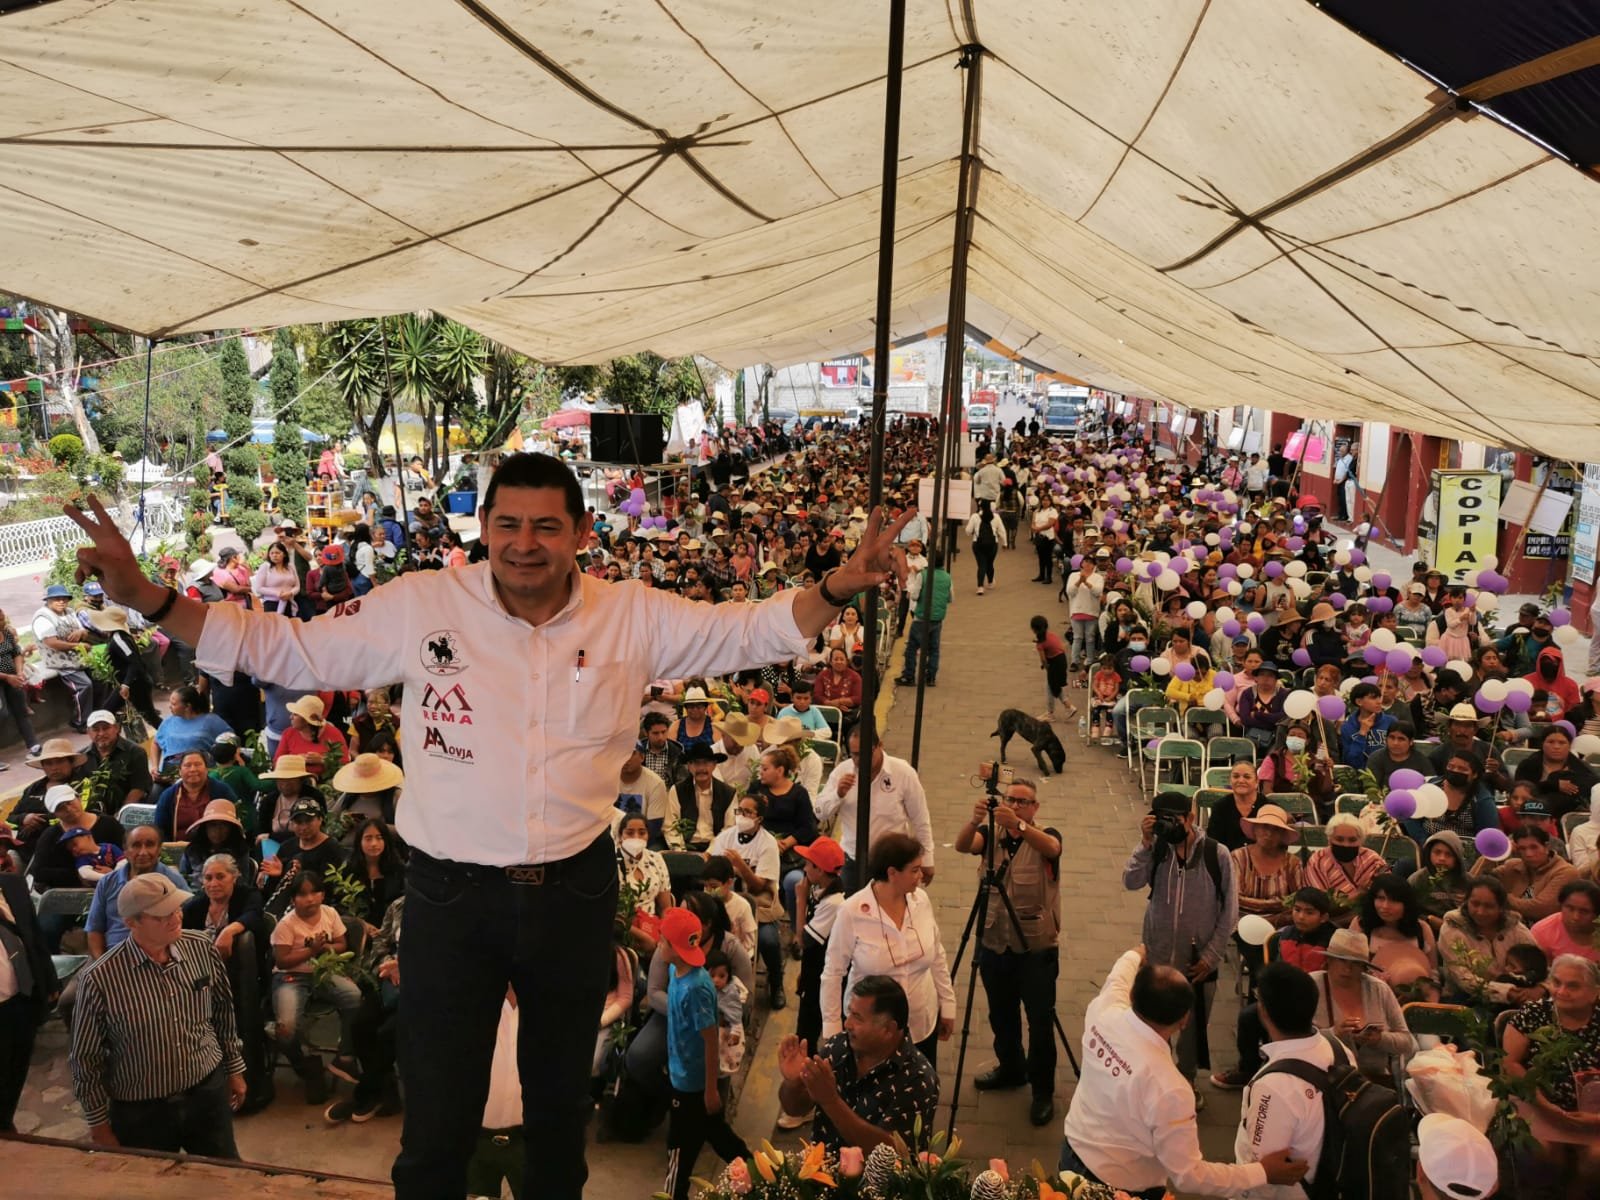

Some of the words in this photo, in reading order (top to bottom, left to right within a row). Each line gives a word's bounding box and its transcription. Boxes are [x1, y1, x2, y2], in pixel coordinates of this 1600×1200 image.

[1454, 478, 1482, 581] COPIAS
[423, 710, 473, 725] REMA
[1253, 1094, 1272, 1146] TERRITORIAL
